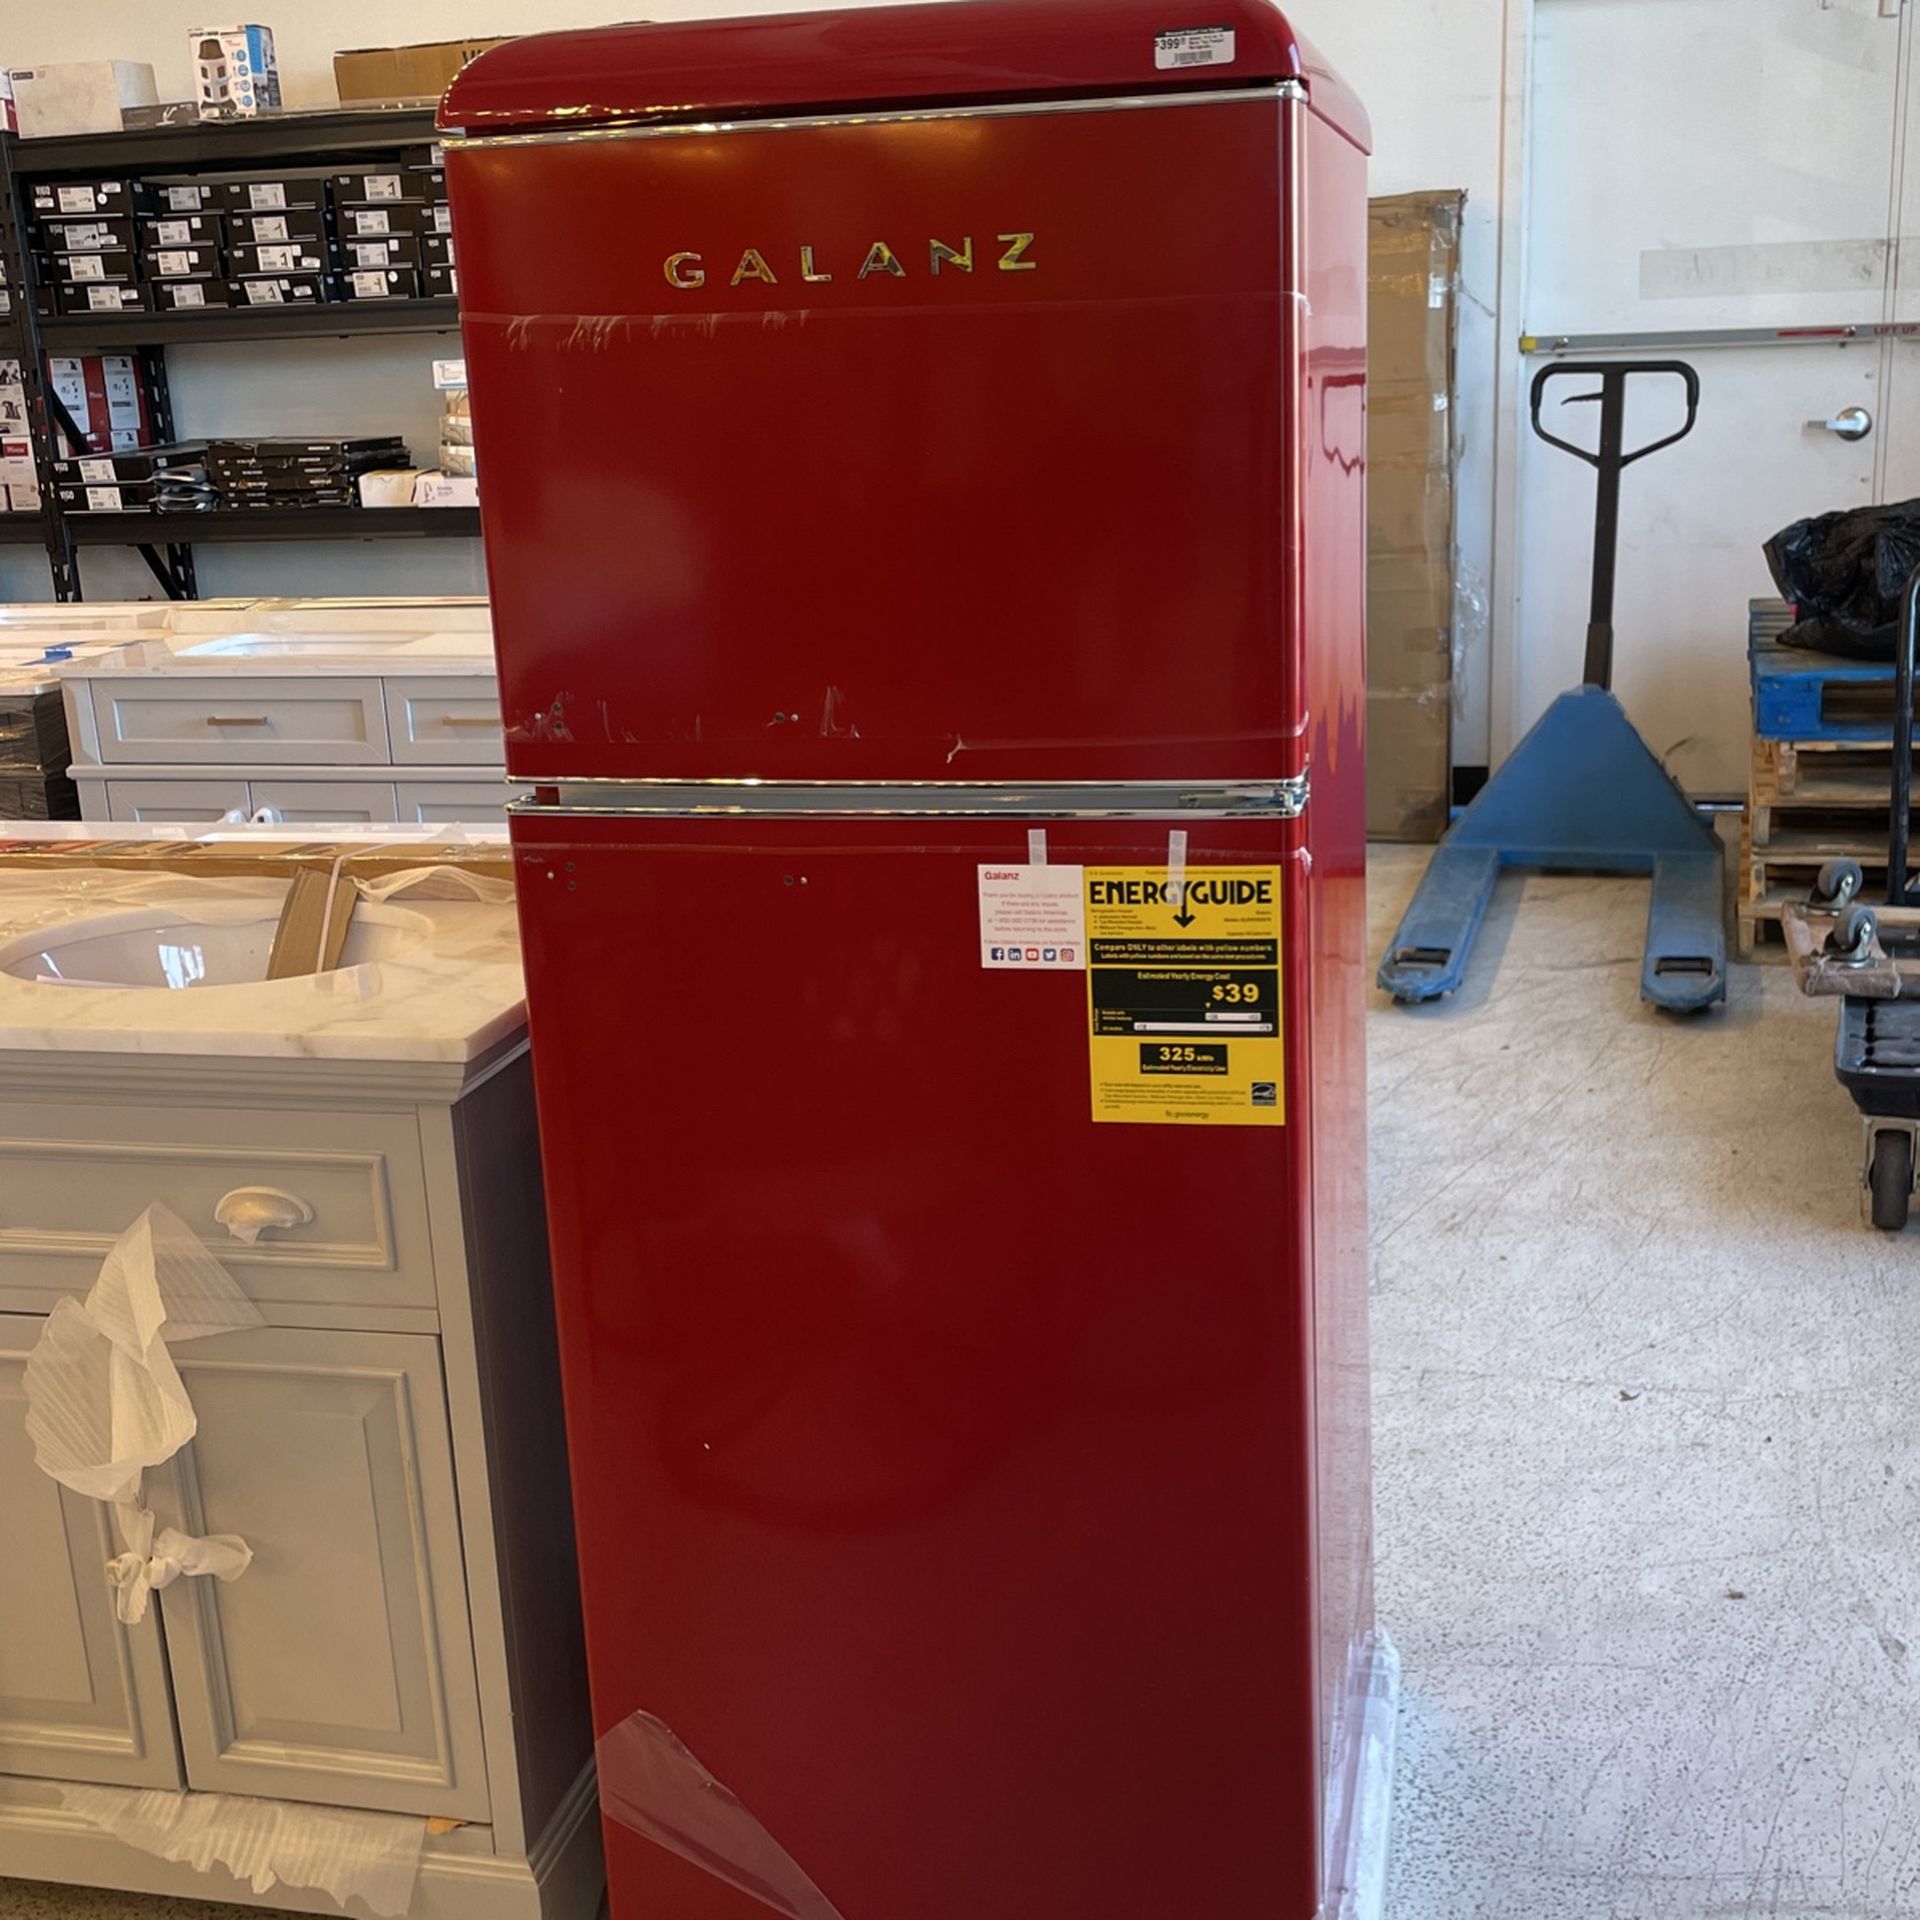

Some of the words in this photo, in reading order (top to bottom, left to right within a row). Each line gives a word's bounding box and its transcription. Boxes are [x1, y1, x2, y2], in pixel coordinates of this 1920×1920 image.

[663, 233, 1036, 289] GALANZ
[1873, 326, 1897, 335] LIFT
[1902, 325, 1917, 334] UP
[984, 871, 1020, 880] Galanz
[1094, 943, 1126, 952] Compare
[1127, 943, 1147, 951] ONLY
[1137, 971, 1170, 980] Estimated
[1171, 972, 1190, 981] Yearly
[1191, 972, 1213, 981] Energy
[1214, 972, 1231, 980] Cost
[1212, 983, 1259, 1003] $39
[1159, 1047, 1195, 1061] 325
